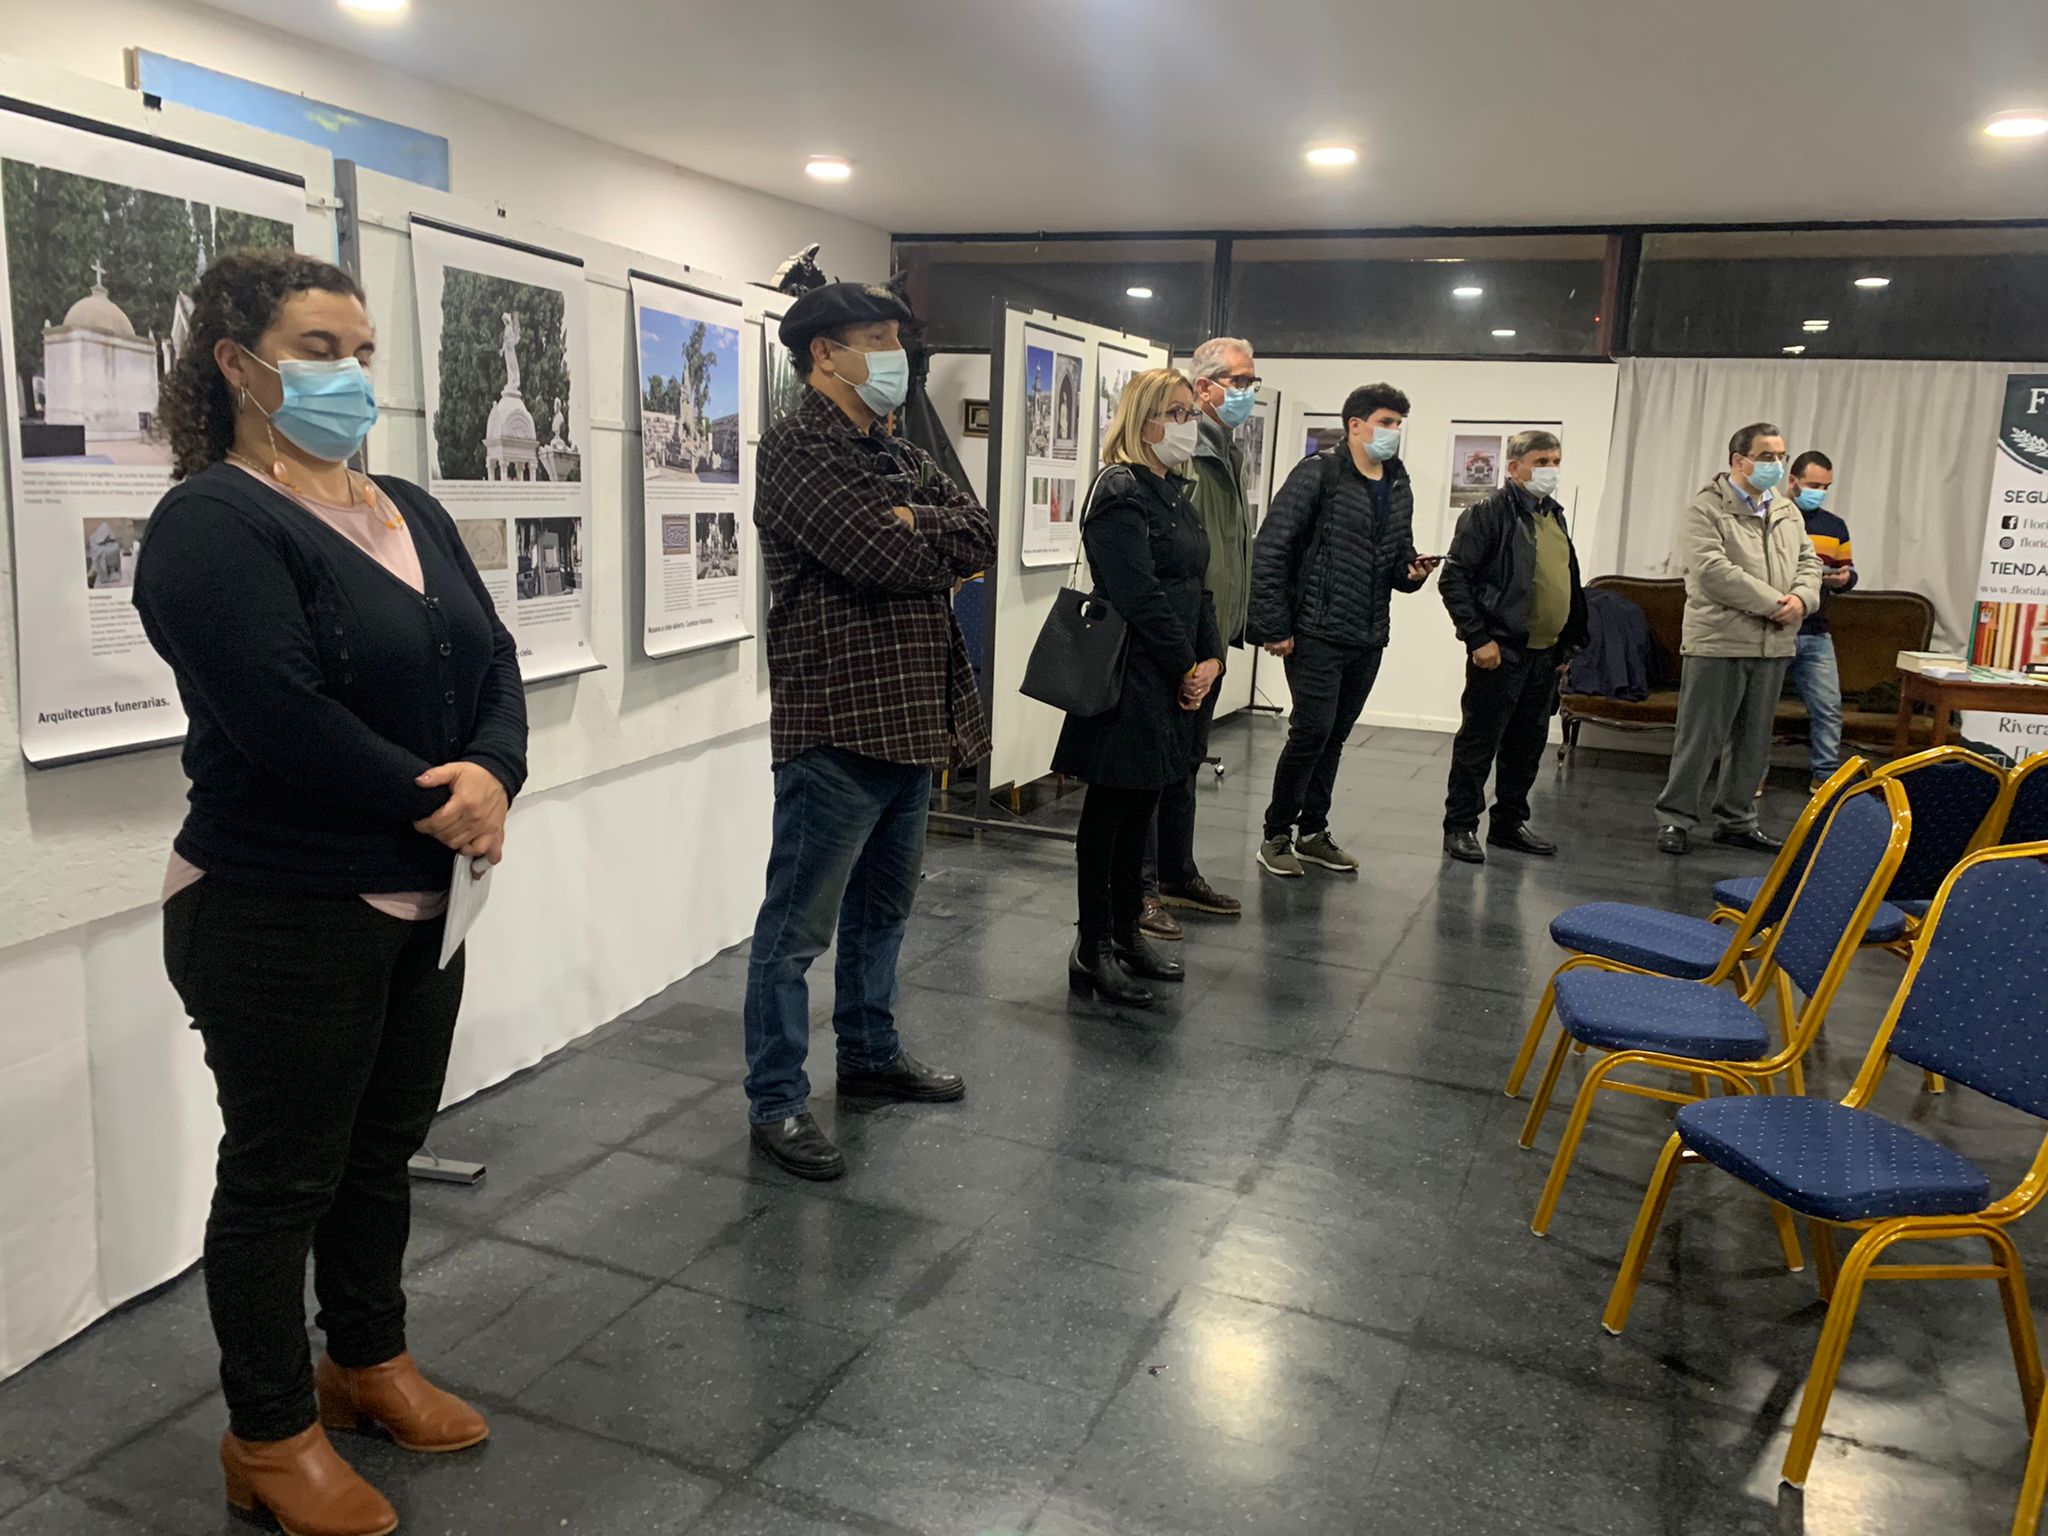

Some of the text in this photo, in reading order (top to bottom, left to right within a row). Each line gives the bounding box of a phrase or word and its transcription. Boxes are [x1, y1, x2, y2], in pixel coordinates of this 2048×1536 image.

[1990, 561, 2048, 577] TIENDA
[38, 697, 170, 724] Arquitecturas funerarias.
